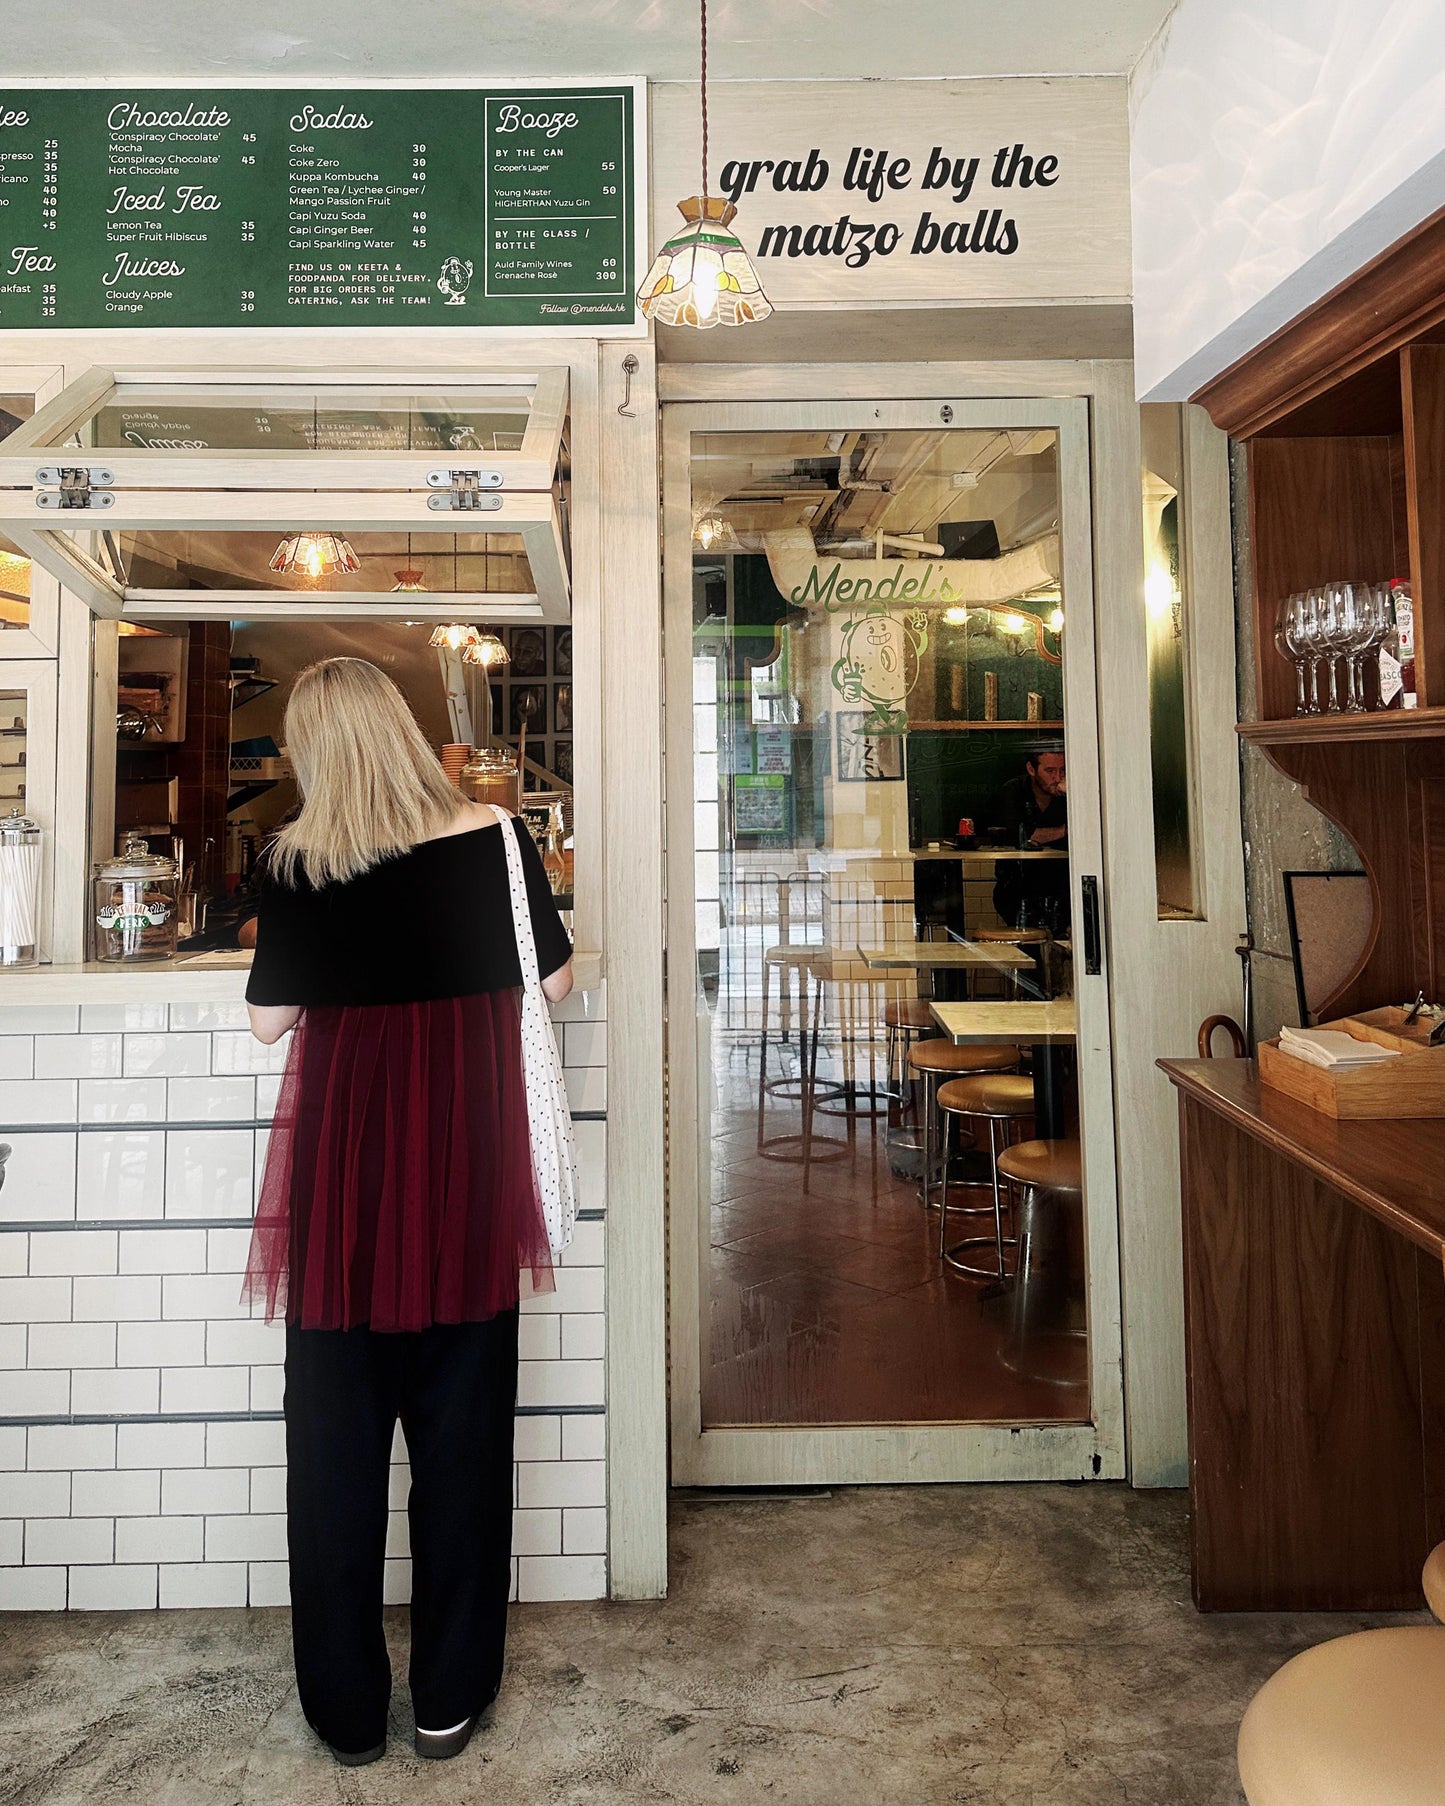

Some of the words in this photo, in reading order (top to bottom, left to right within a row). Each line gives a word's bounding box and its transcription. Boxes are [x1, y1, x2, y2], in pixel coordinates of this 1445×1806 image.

[108, 103, 231, 130] Chocolate
[290, 105, 373, 132] Sodas
[496, 105, 578, 138] Booze
[45, 140, 58, 148] 25
[109, 144, 142, 152] Mocha
[289, 144, 314, 152] Coke
[413, 144, 426, 152] 30
[242, 156, 255, 164] 45
[289, 158, 314, 166] Coke
[44, 163, 57, 171] 35
[129, 166, 179, 174] Chocolate
[529, 164, 550, 172] Lager
[602, 162, 615, 170] 55
[290, 173, 321, 182] Kuppa
[413, 172, 426, 180] 40
[719, 148, 830, 204] grab
[842, 147, 912, 203] life
[921, 146, 980, 203] by
[991, 143, 1060, 189] the
[44, 175, 57, 183] 35
[43, 186, 57, 194] 40
[289, 186, 319, 194] Green
[322, 186, 339, 194] Tea
[349, 186, 383, 195] Lychee
[386, 186, 419, 195] Ginger
[603, 186, 616, 194] 50
[494, 190, 521, 199] Young
[106, 186, 165, 213] Iced
[172, 186, 221, 213] Tea
[290, 197, 324, 206] Mango
[327, 197, 364, 205] Passion
[368, 197, 390, 205] Fruit
[43, 209, 56, 217] 40
[289, 212, 311, 221] Capi
[314, 212, 338, 220] Yuzu
[342, 212, 365, 220] Soda
[43, 221, 56, 229] +5
[144, 221, 161, 229] Tea
[242, 221, 255, 229] 35
[289, 226, 311, 235] Capi
[314, 226, 348, 235] Ginger
[351, 226, 373, 234] Beer
[107, 233, 136, 242] Super
[139, 233, 162, 241] Fruit
[241, 233, 254, 241] 35
[757, 214, 905, 268] matzo
[910, 208, 1020, 255] balls
[289, 240, 311, 249] Capi
[314, 240, 361, 249] Sparkling
[364, 240, 394, 248] Water
[7, 247, 56, 275] Tea
[517, 261, 544, 269] Family
[603, 258, 616, 266] 60
[103, 252, 185, 285] Juices
[596, 272, 616, 280] 300
[0, 284, 31, 292] akfast
[43, 285, 56, 293] 35
[106, 290, 141, 300] Cloudy
[143, 290, 172, 300] Apple
[241, 291, 254, 299] 30
[43, 296, 56, 304] 35
[288, 297, 342, 305] CATERING,
[106, 303, 143, 313] Orange
[241, 303, 254, 311] 30
[539, 304, 568, 314] Follow
[42, 308, 55, 316] 35
[791, 563, 963, 613] Mendel's
[119, 917, 146, 929] PERK
